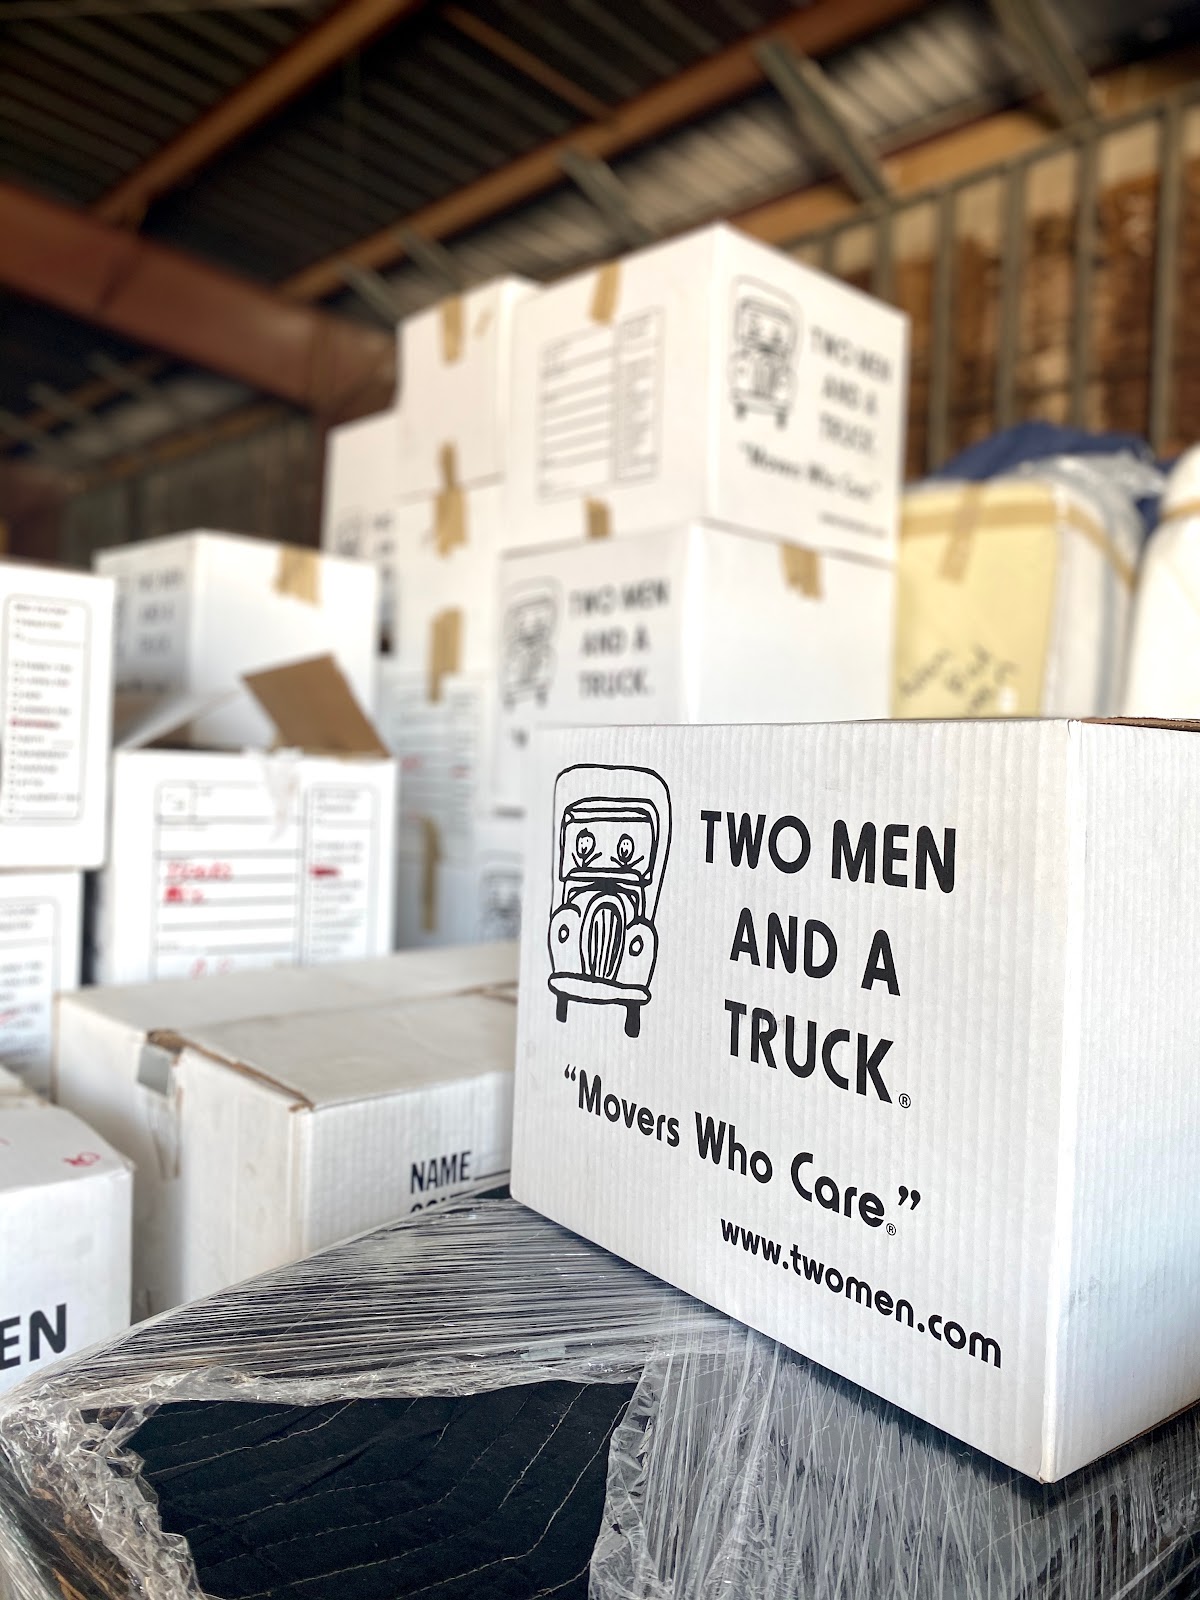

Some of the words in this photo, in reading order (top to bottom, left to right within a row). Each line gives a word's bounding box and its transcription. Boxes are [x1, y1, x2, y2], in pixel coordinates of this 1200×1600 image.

[700, 809, 811, 875] TWO
[831, 819, 957, 894] MEN
[729, 907, 838, 979] AND
[860, 929, 901, 997] A
[410, 1150, 471, 1194] NAME
[695, 1111, 773, 1184] Who
[720, 1218, 1002, 1369] www.twomen.com
